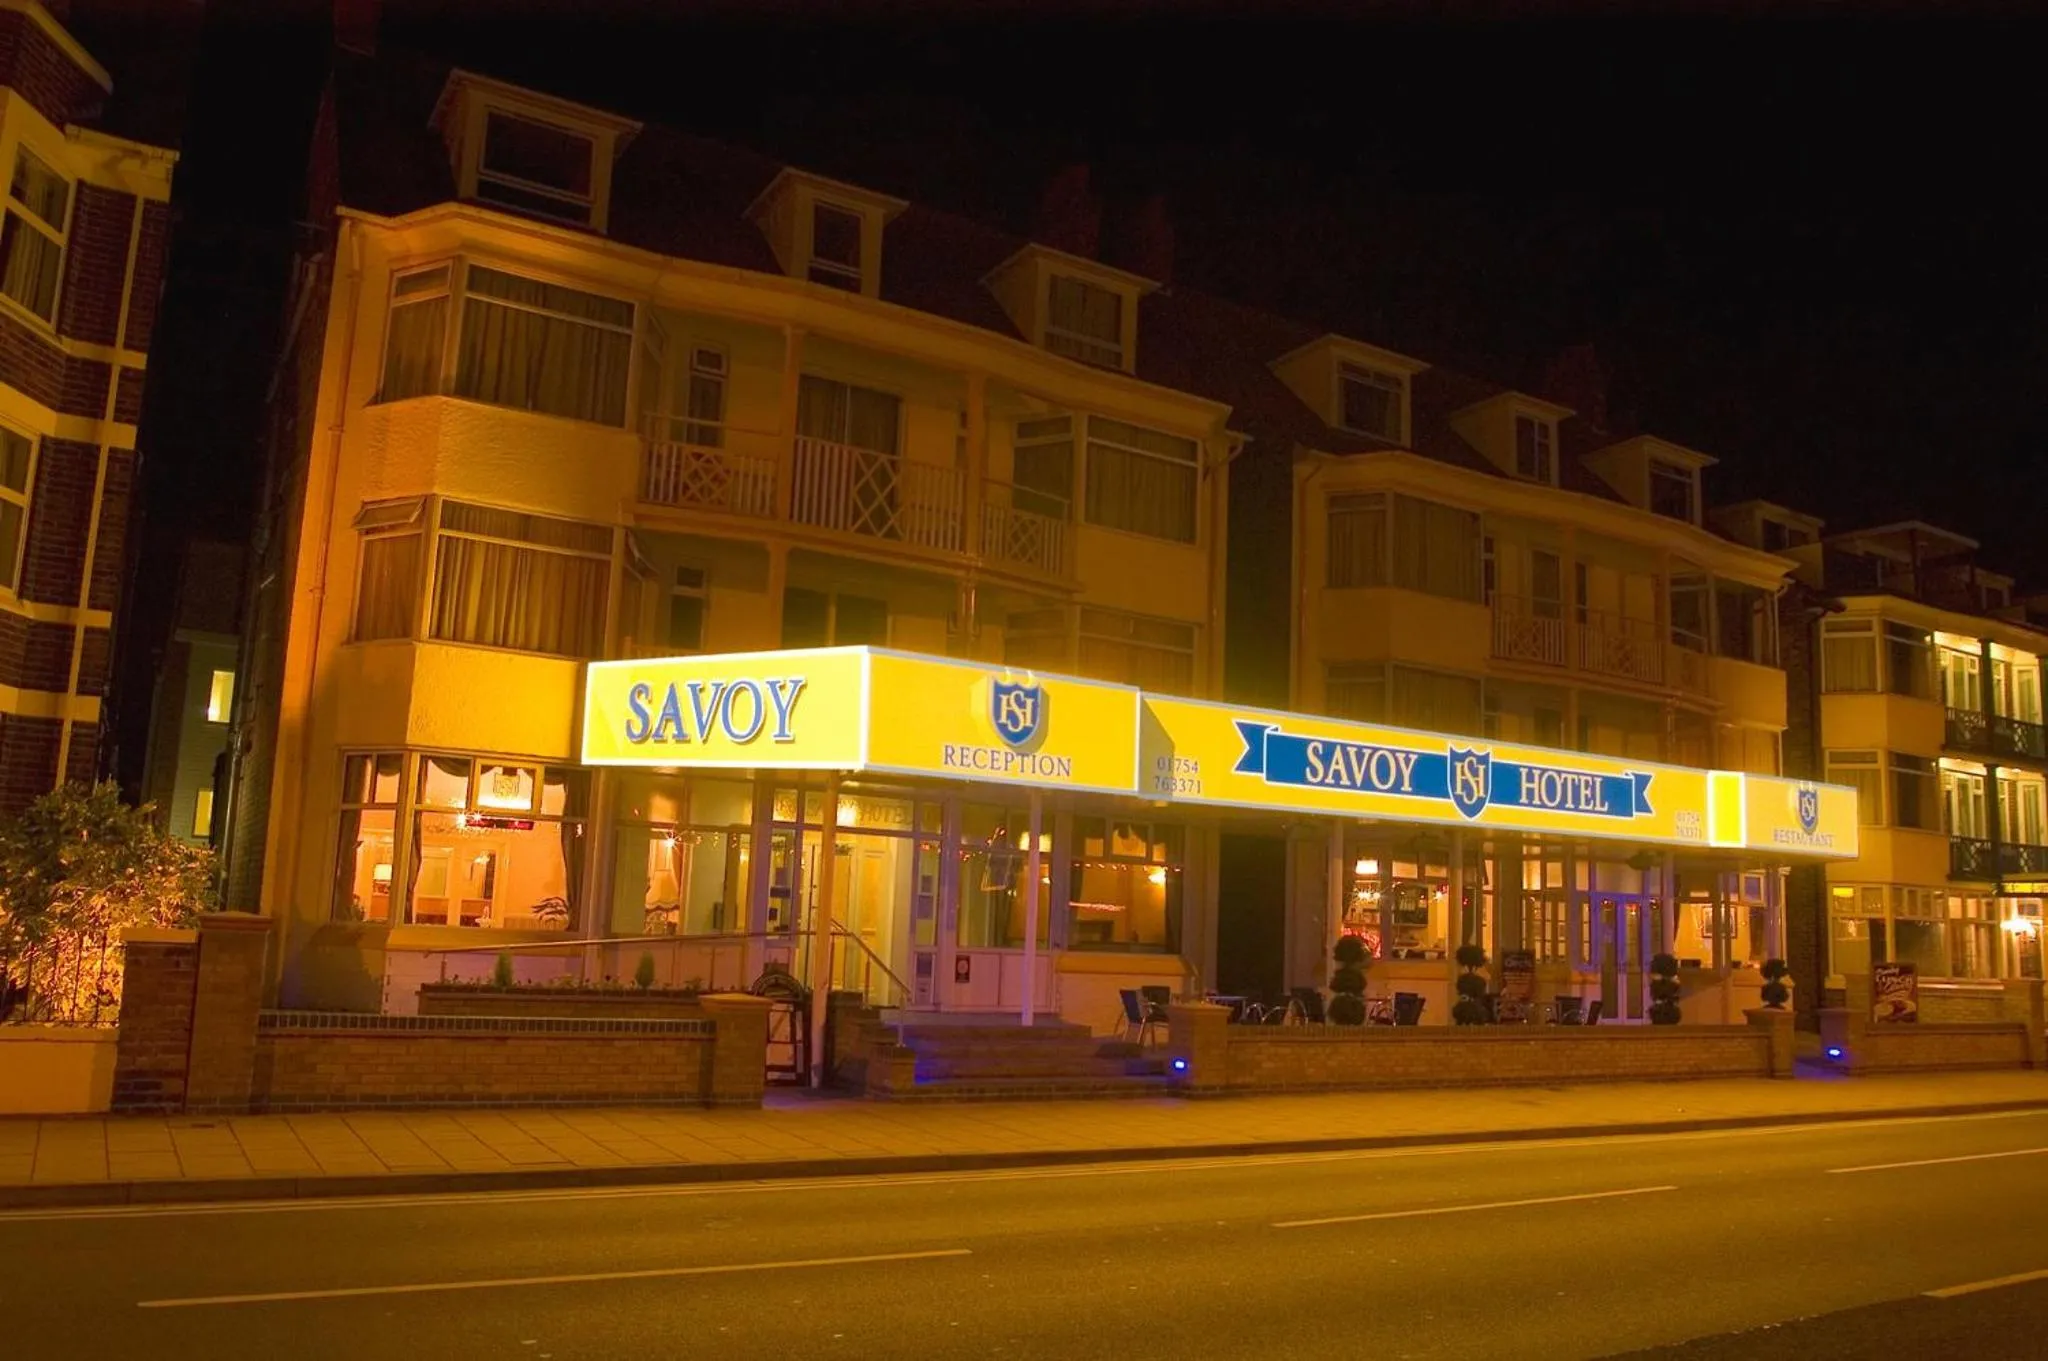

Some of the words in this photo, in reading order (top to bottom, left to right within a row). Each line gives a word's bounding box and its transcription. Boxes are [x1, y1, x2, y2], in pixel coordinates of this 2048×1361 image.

[625, 678, 805, 743] SAVOY
[943, 744, 1072, 777] RECEPTION
[1157, 756, 1199, 774] 01754
[1305, 741, 1419, 792] SAVOY
[1519, 766, 1609, 812] HOTEL
[1773, 829, 1835, 848] RESTAURANT
